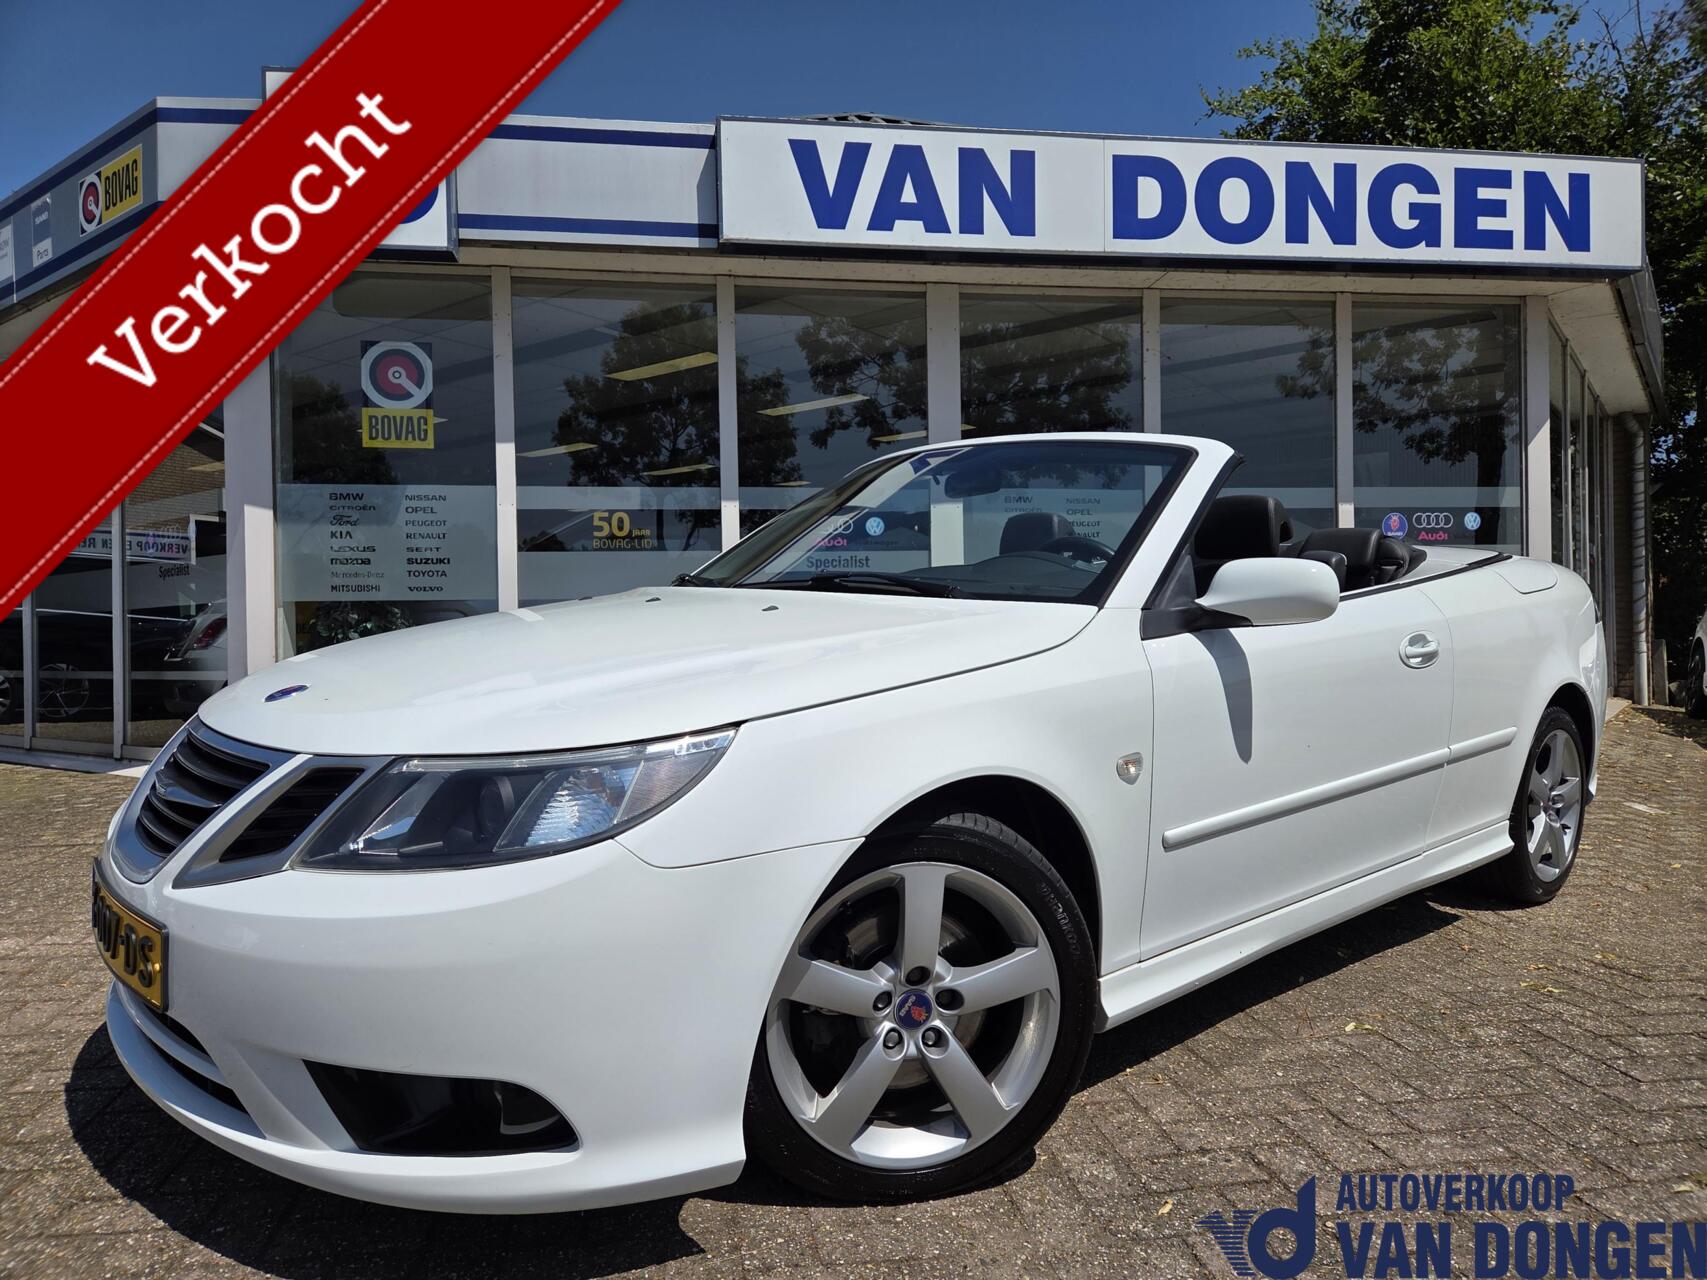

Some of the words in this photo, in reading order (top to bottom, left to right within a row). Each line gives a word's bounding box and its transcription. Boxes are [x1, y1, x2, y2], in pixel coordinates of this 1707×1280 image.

[104, 158, 139, 211] BOVAG
[787, 138, 1036, 237] VAN
[1112, 154, 1591, 253] DONGEN
[368, 414, 428, 442] BOVAG
[329, 492, 365, 501] BMW
[1004, 495, 1033, 504] BMW
[1066, 497, 1101, 505] NISSAN
[405, 506, 438, 514] OPEL
[1066, 508, 1092, 516] OPEL
[329, 514, 359, 527] Ford
[593, 511, 630, 537] 50
[1070, 519, 1100, 527] EUGEOT
[330, 530, 353, 540] KIA
[406, 532, 448, 540] RENAULT
[1418, 531, 1449, 541] Audi
[330, 545, 376, 553] LEXUS
[406, 557, 451, 565] SUZUKI
[806, 555, 871, 571] Specialist
[159, 564, 191, 580] Specialist
[407, 570, 448, 578] TOYOTA
[330, 584, 381, 593] MITSUBISHI
